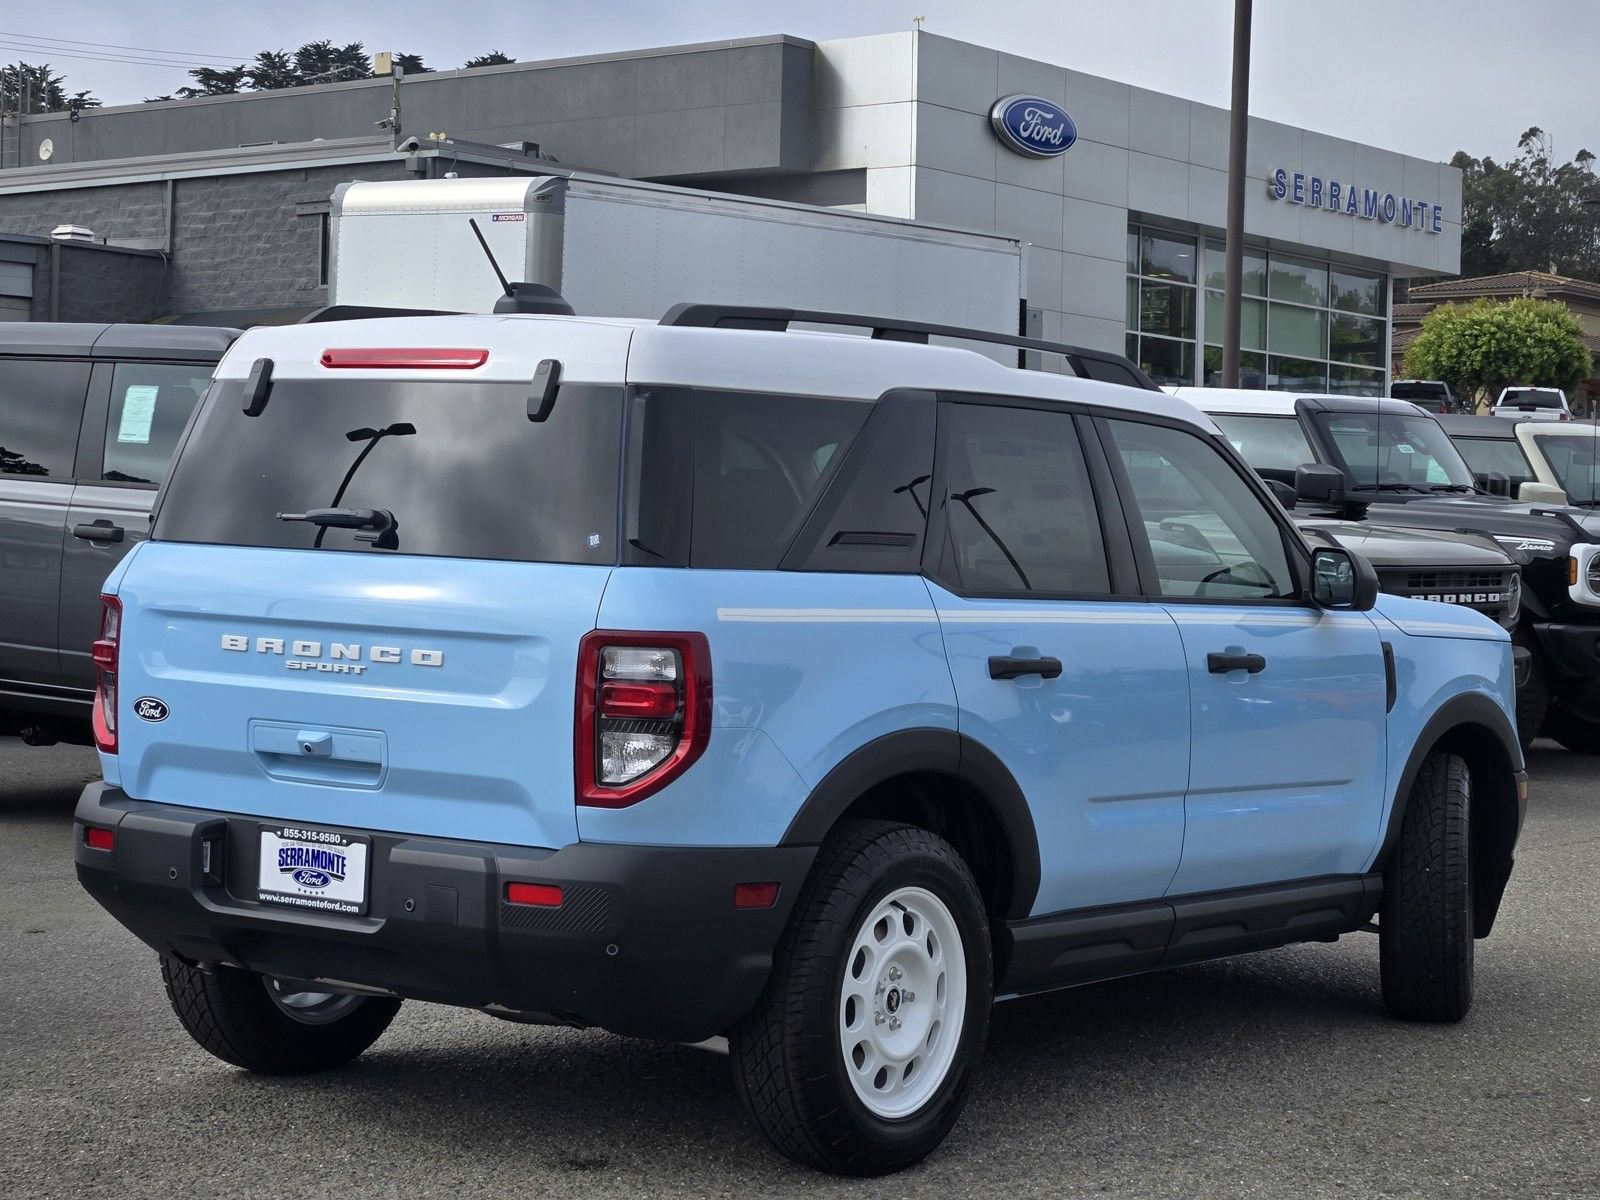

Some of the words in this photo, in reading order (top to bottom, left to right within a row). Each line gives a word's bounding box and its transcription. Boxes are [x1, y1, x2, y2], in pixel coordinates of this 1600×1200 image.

[1020, 107, 1064, 145] Ford
[1270, 167, 1442, 233] SERRAMONTE
[221, 634, 444, 666] BRONCO
[285, 660, 367, 674] SPORT
[138, 700, 162, 718] Ford
[283, 828, 341, 844] 855-315-9580
[278, 847, 347, 876] SERRAMONTE
[299, 870, 324, 885] Ford
[259, 892, 359, 913] www.serramonteford.com
